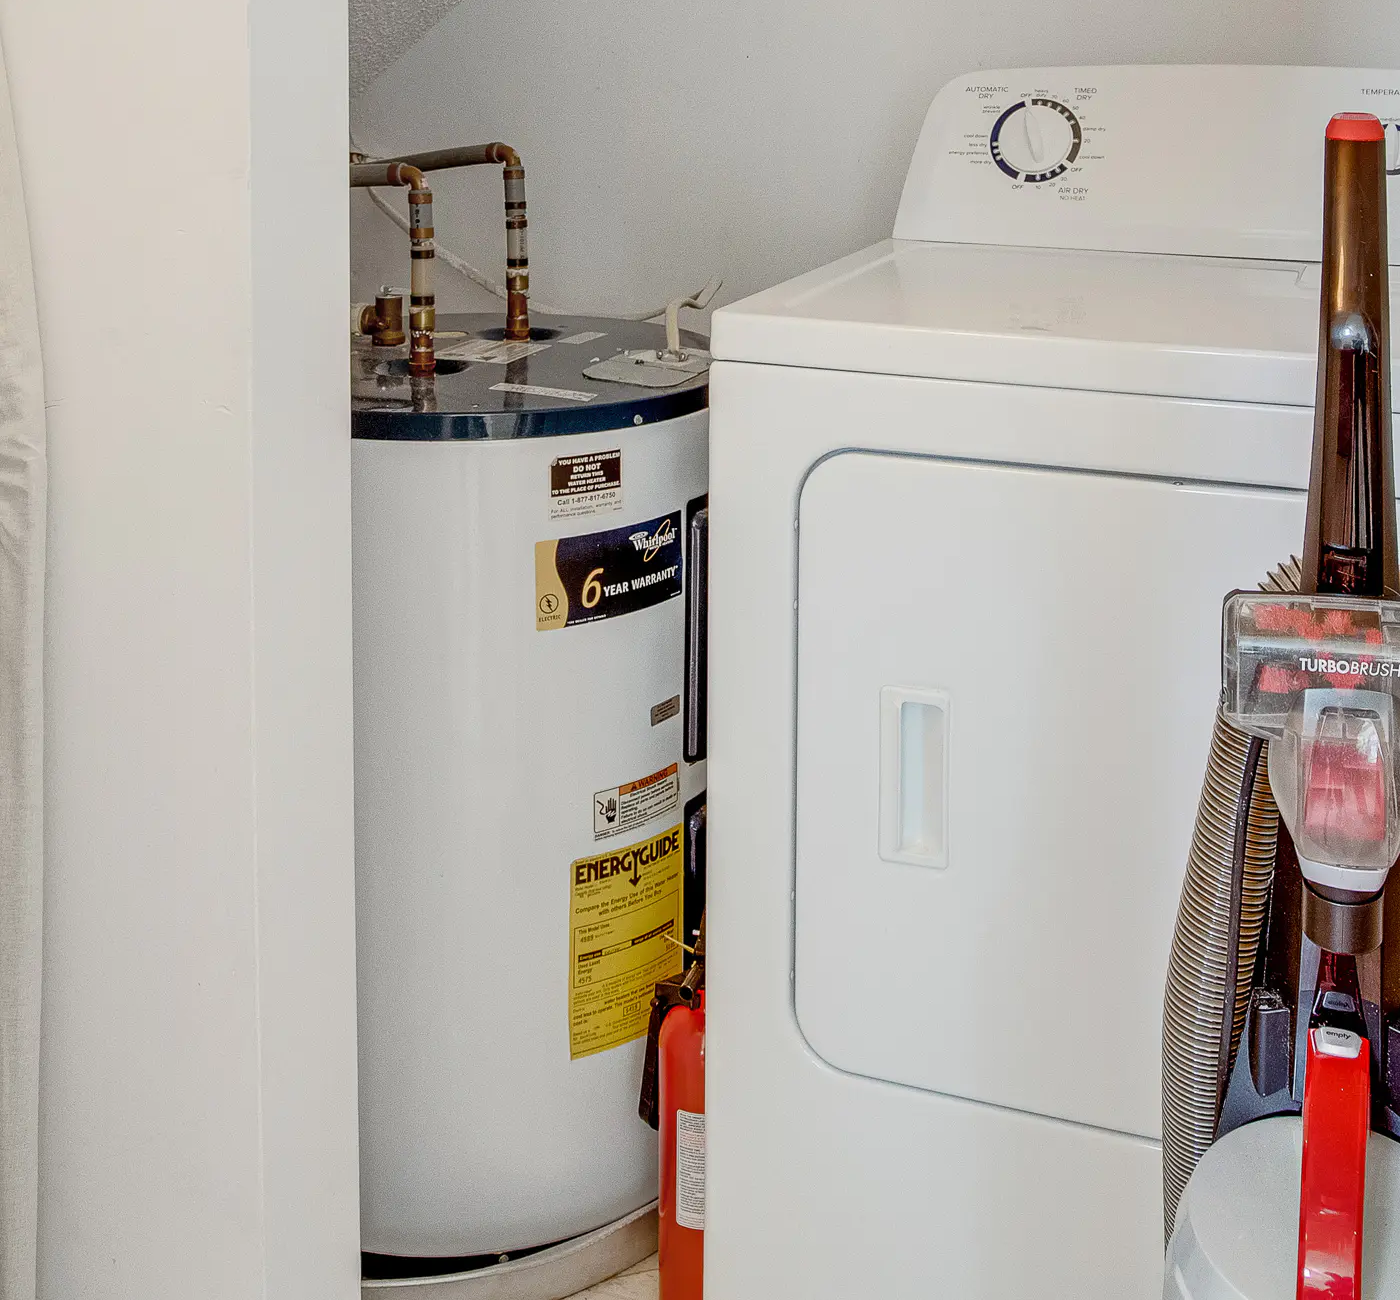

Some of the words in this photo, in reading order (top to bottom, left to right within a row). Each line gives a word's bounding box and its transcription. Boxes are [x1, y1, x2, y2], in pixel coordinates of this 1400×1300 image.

[558, 458, 571, 466] YOU
[572, 456, 588, 464] HAVE
[594, 451, 621, 462] PROBLEM
[573, 465, 585, 473] DO
[585, 463, 602, 471] NOT
[567, 479, 586, 487] WATER
[586, 476, 607, 484] HEATER
[570, 472, 592, 480] RETURN
[557, 498, 570, 506] Call
[582, 567, 604, 609] 6
[603, 581, 630, 598] YEAR
[539, 614, 562, 623] ELECTRIC
[1299, 657, 1400, 678] TURBOBRUSH
[639, 768, 668, 788] WARNING
[575, 829, 680, 888] ENERGYGUIDE
[575, 904, 600, 914] Compare
[600, 899, 609, 907] the
[610, 895, 628, 905] Energy
[628, 891, 639, 899] Use
[598, 907, 610, 916] with
[610, 902, 627, 912] others
[627, 896, 644, 907] Before
[1326, 1030, 1352, 1039] empty
